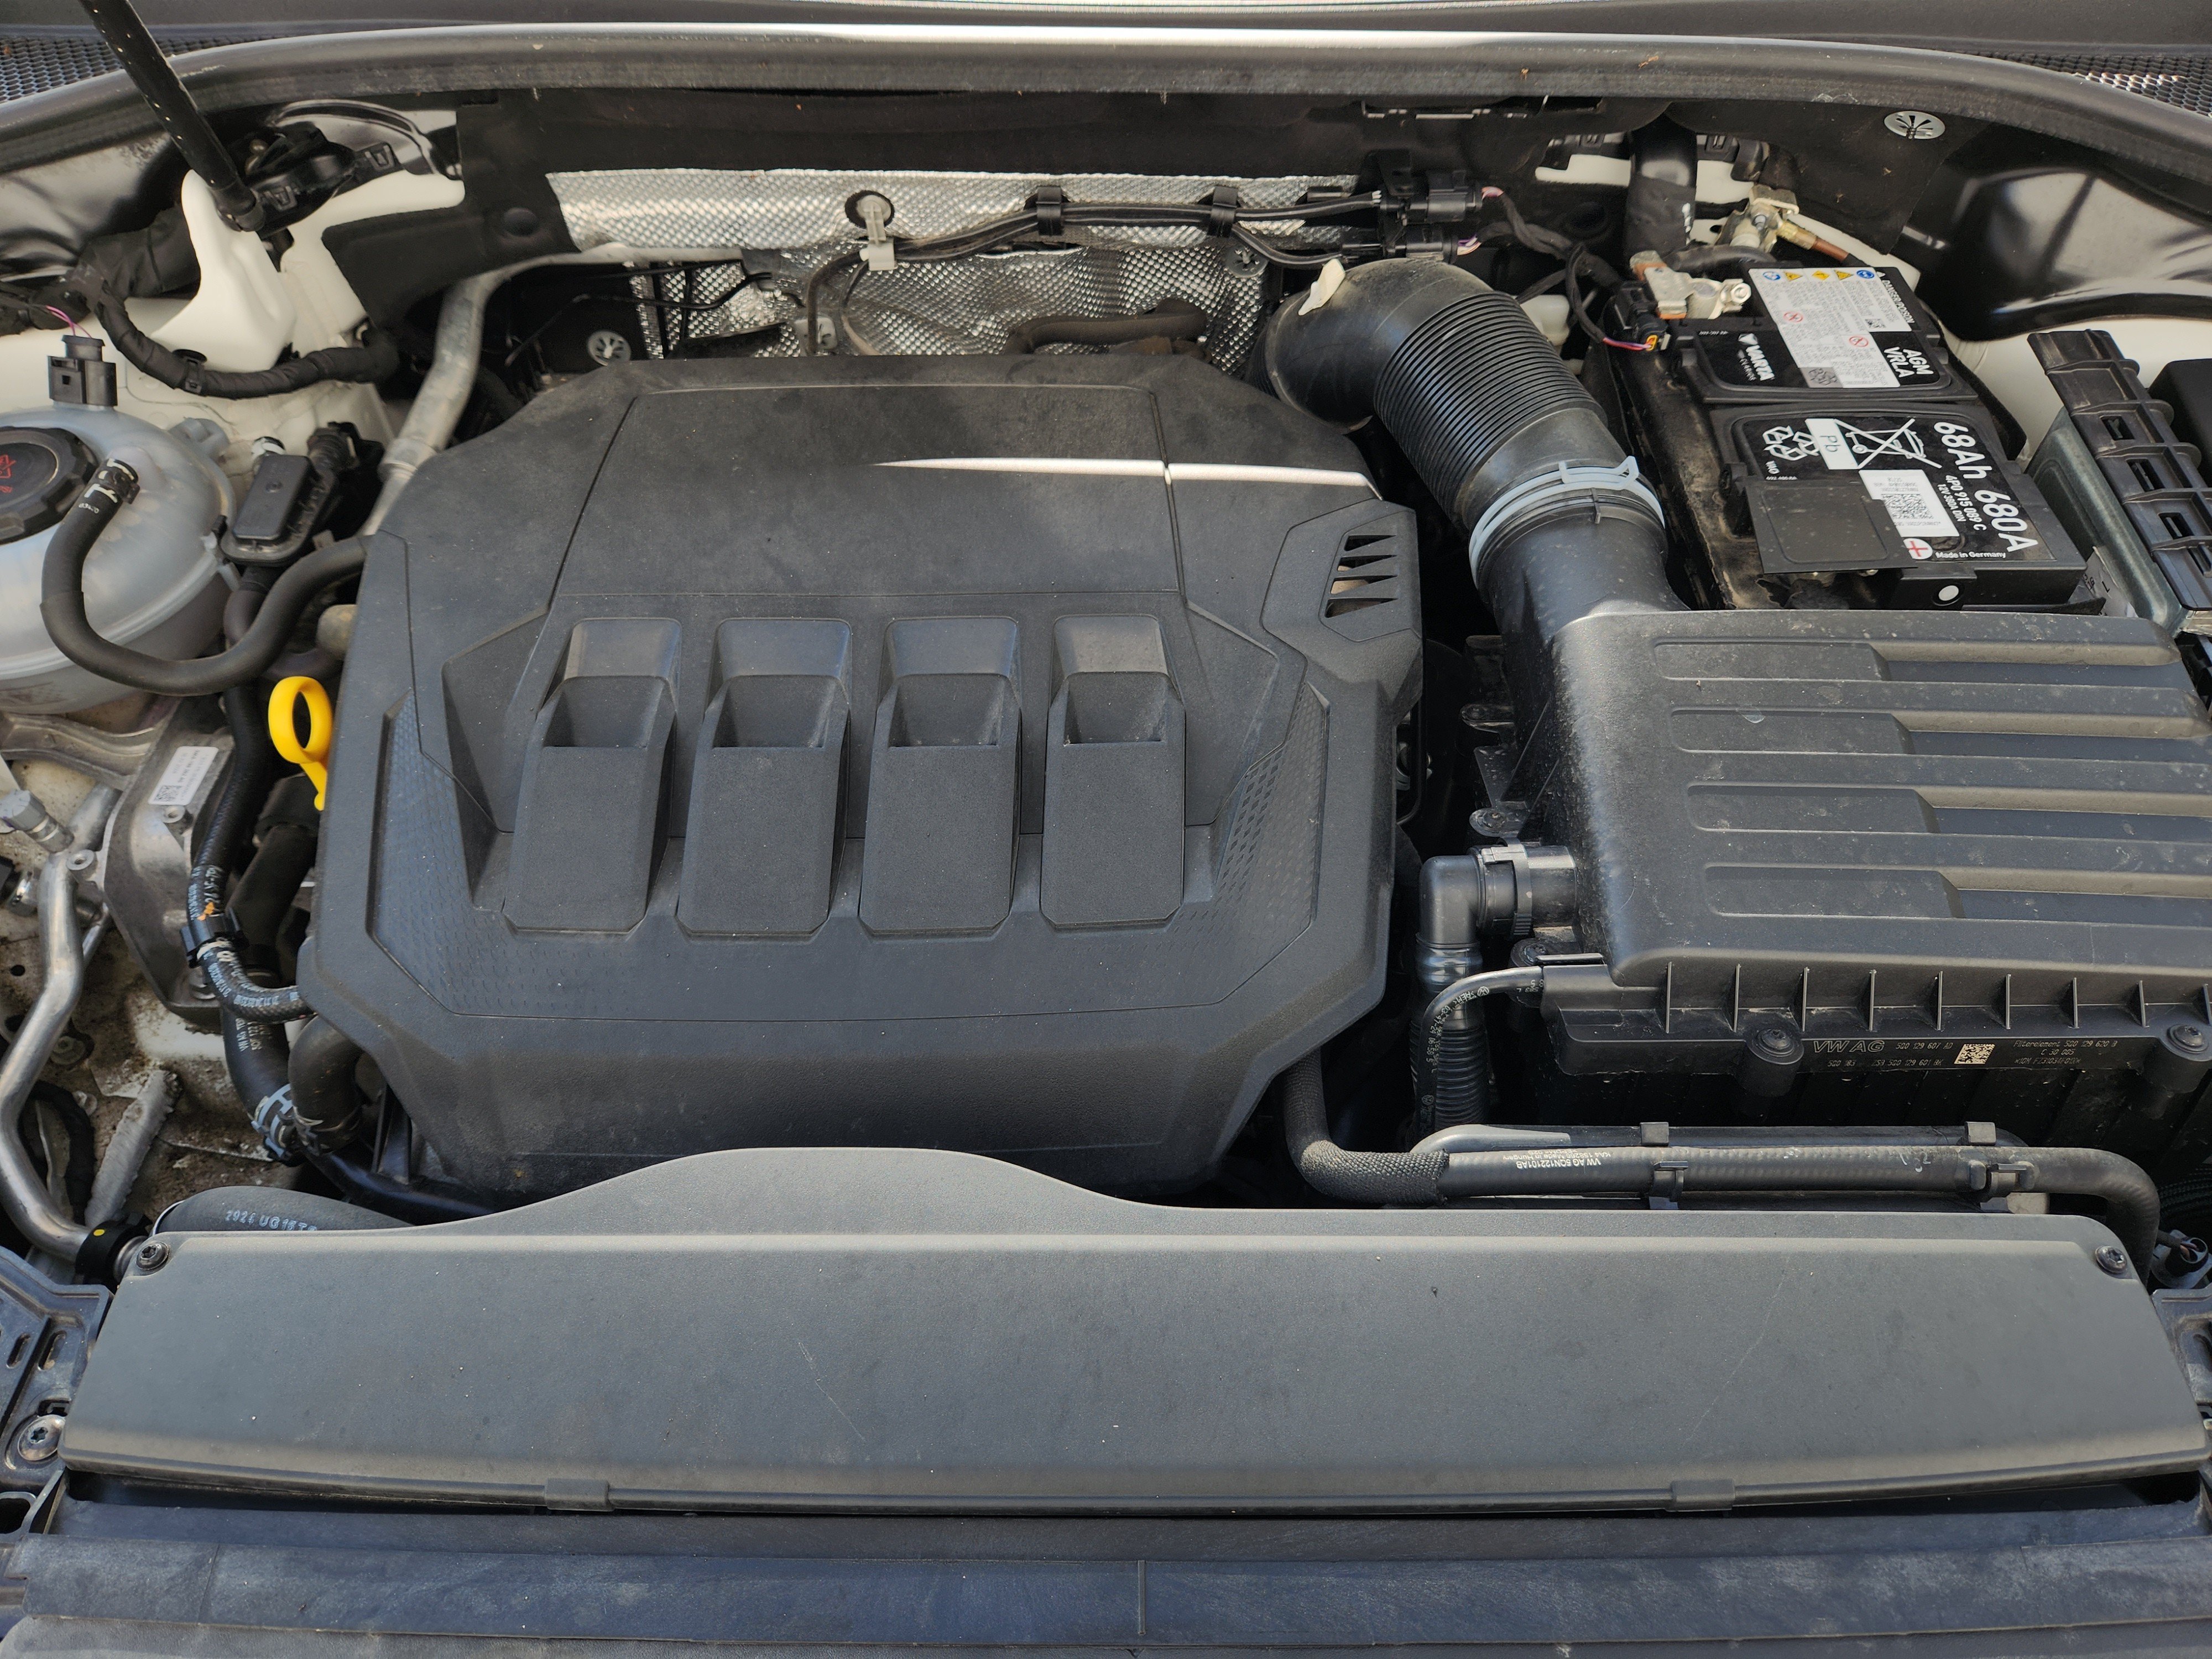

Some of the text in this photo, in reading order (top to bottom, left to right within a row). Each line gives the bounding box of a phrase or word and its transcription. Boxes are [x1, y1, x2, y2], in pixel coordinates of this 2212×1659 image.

[1746, 345, 1775, 381] VARTA
[1883, 346, 1914, 378] VRLA
[1903, 348, 1934, 375] AGM
[1820, 435, 1840, 452] Pb
[1933, 421, 2038, 552] 68Ah 680A
[1937, 484, 1951, 495] 12V
[1952, 509, 1966, 522] DIN
[1955, 490, 1973, 507] 915
[1963, 505, 1983, 523] 089
[1813, 1041, 1849, 1052] VW
[1849, 1040, 1885, 1052] AG
[1573, 1158, 1585, 1167] AG
[1587, 1157, 1601, 1166] VW
